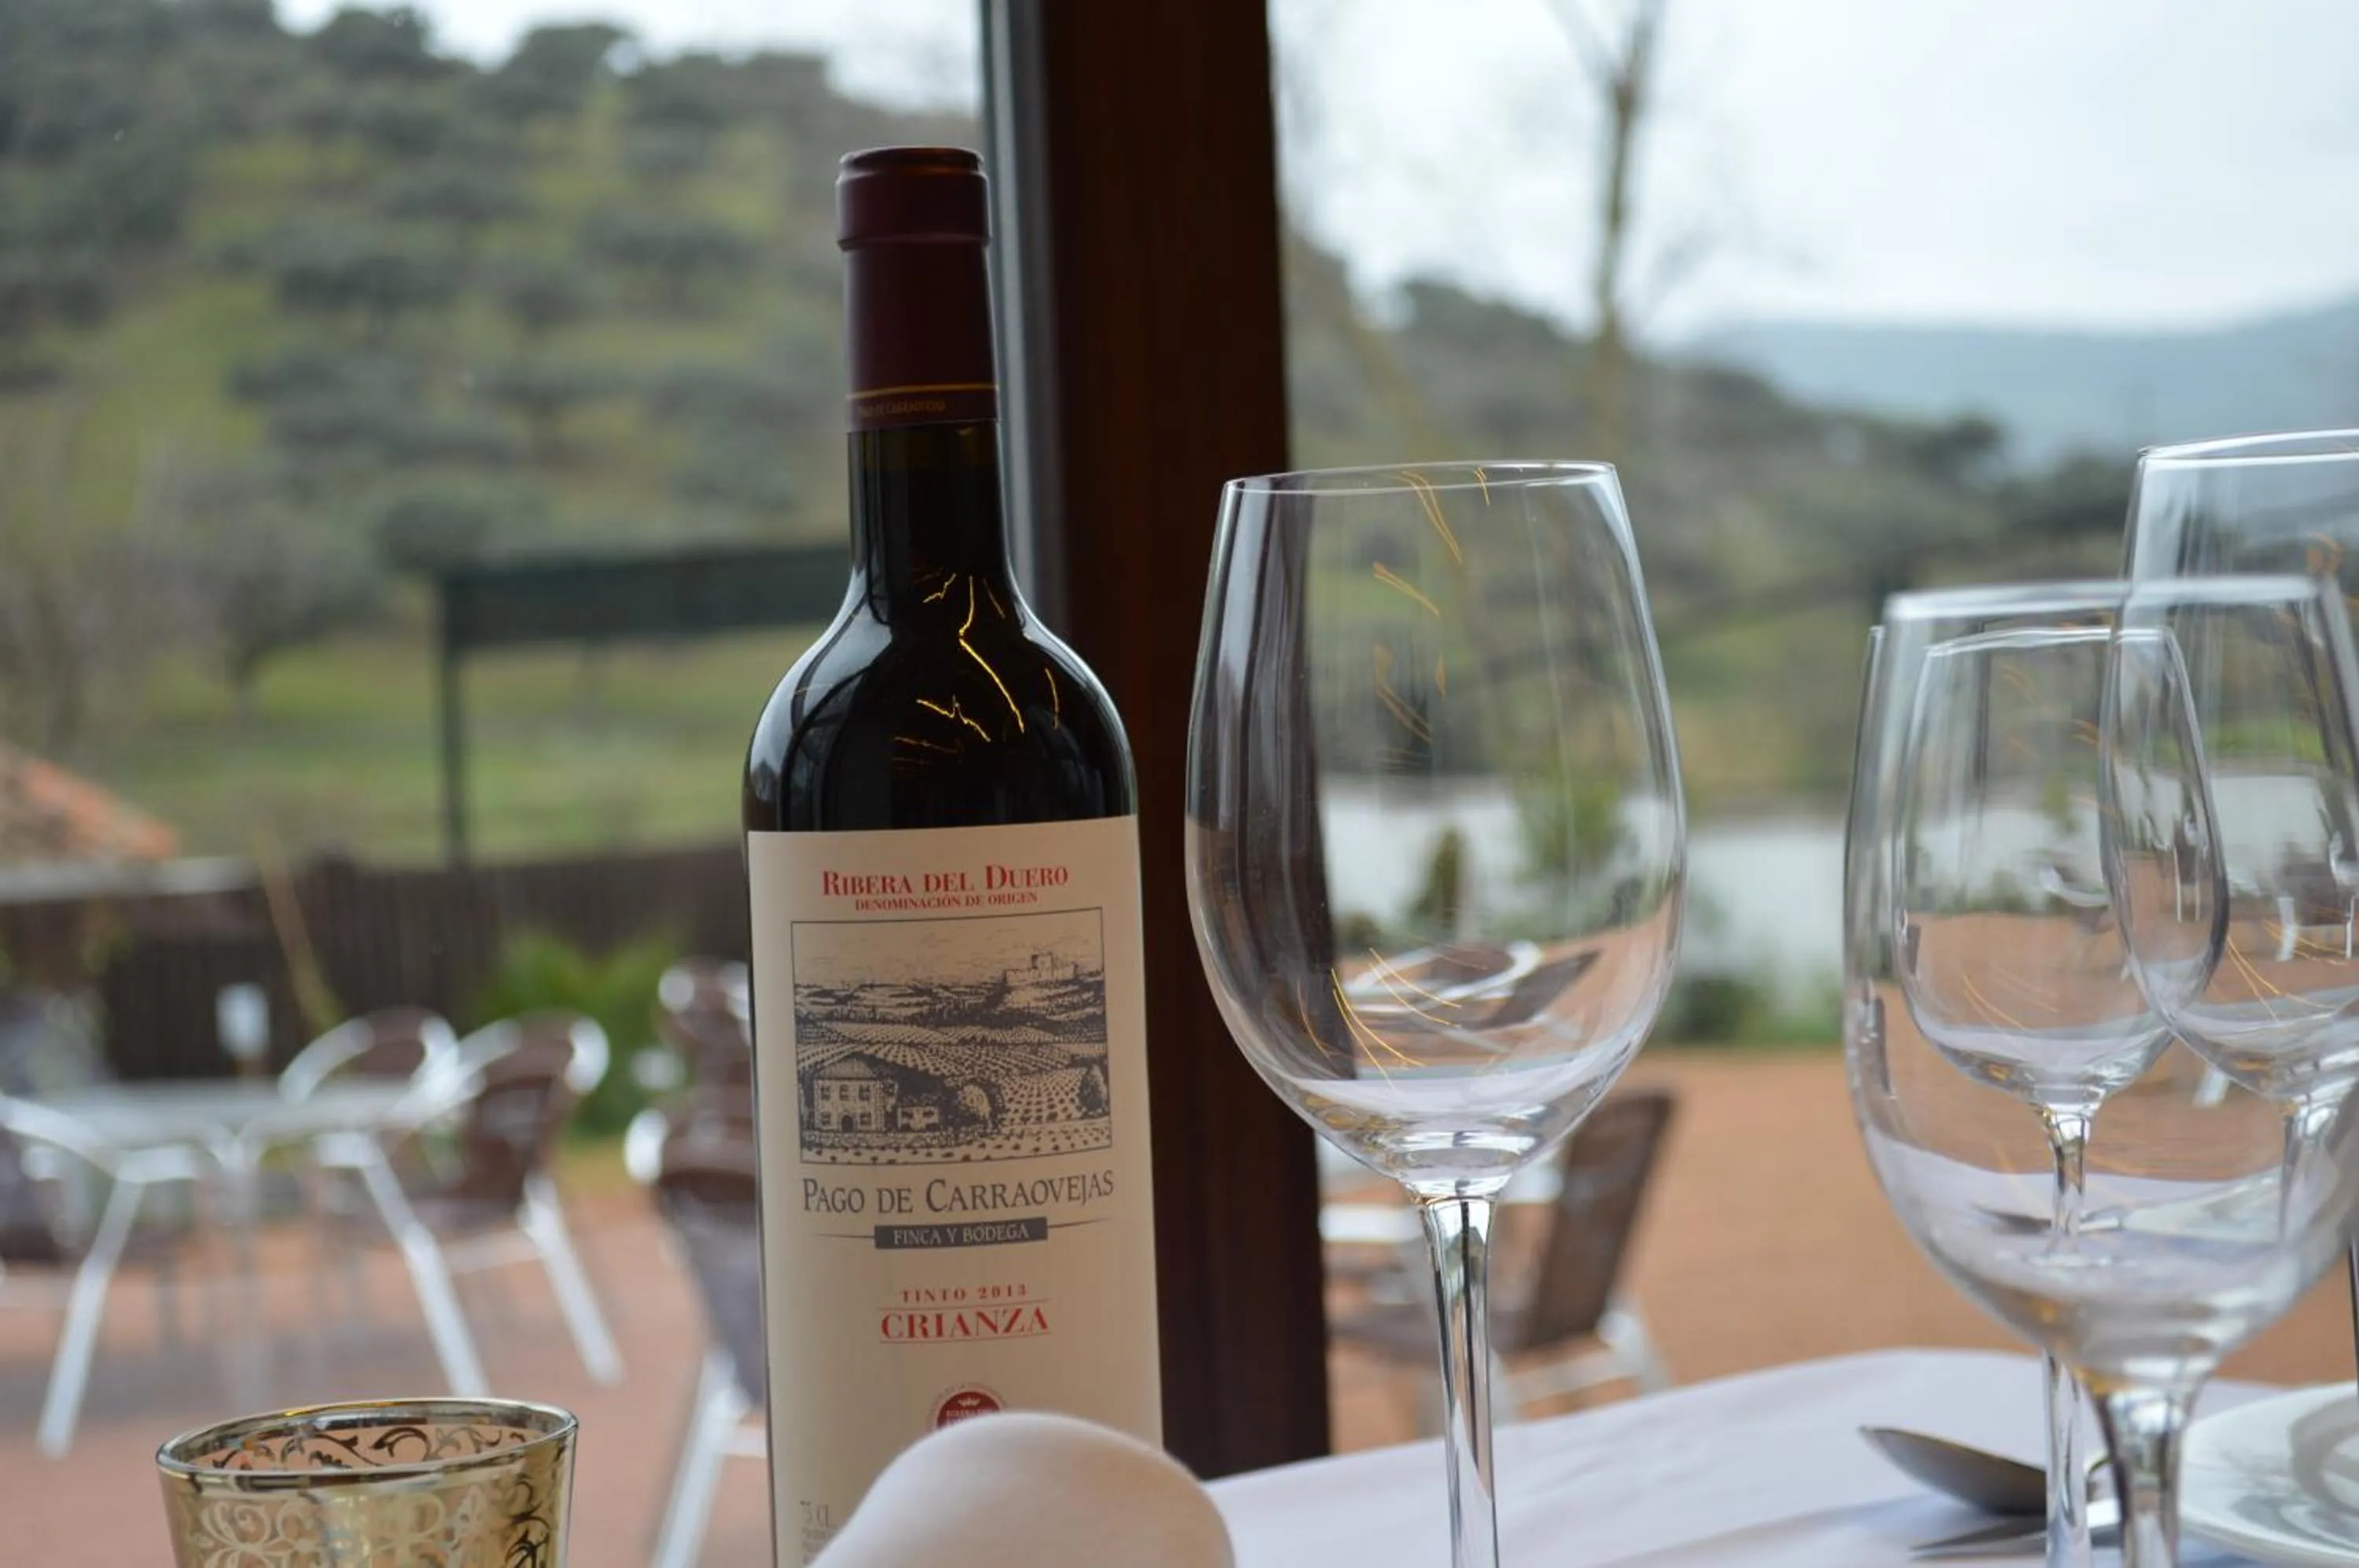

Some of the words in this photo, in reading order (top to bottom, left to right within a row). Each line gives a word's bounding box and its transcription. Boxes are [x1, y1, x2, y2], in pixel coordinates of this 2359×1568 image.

[823, 870, 912, 896] RIBERA
[924, 871, 974, 893] DEL
[984, 865, 1069, 891] DUERO
[966, 895, 984, 907] DE
[988, 891, 1038, 905] ORIGEN
[803, 1178, 865, 1213] PAGO
[878, 1187, 914, 1214] DE
[926, 1170, 1115, 1213] CARRAOVEJAS
[893, 1229, 942, 1246] FINCA
[946, 1228, 957, 1244] Y
[962, 1223, 1029, 1243] BODEGA
[900, 1288, 966, 1303] TINTO
[977, 1283, 1028, 1300] 2013
[881, 1307, 1049, 1338] CRIANZA
